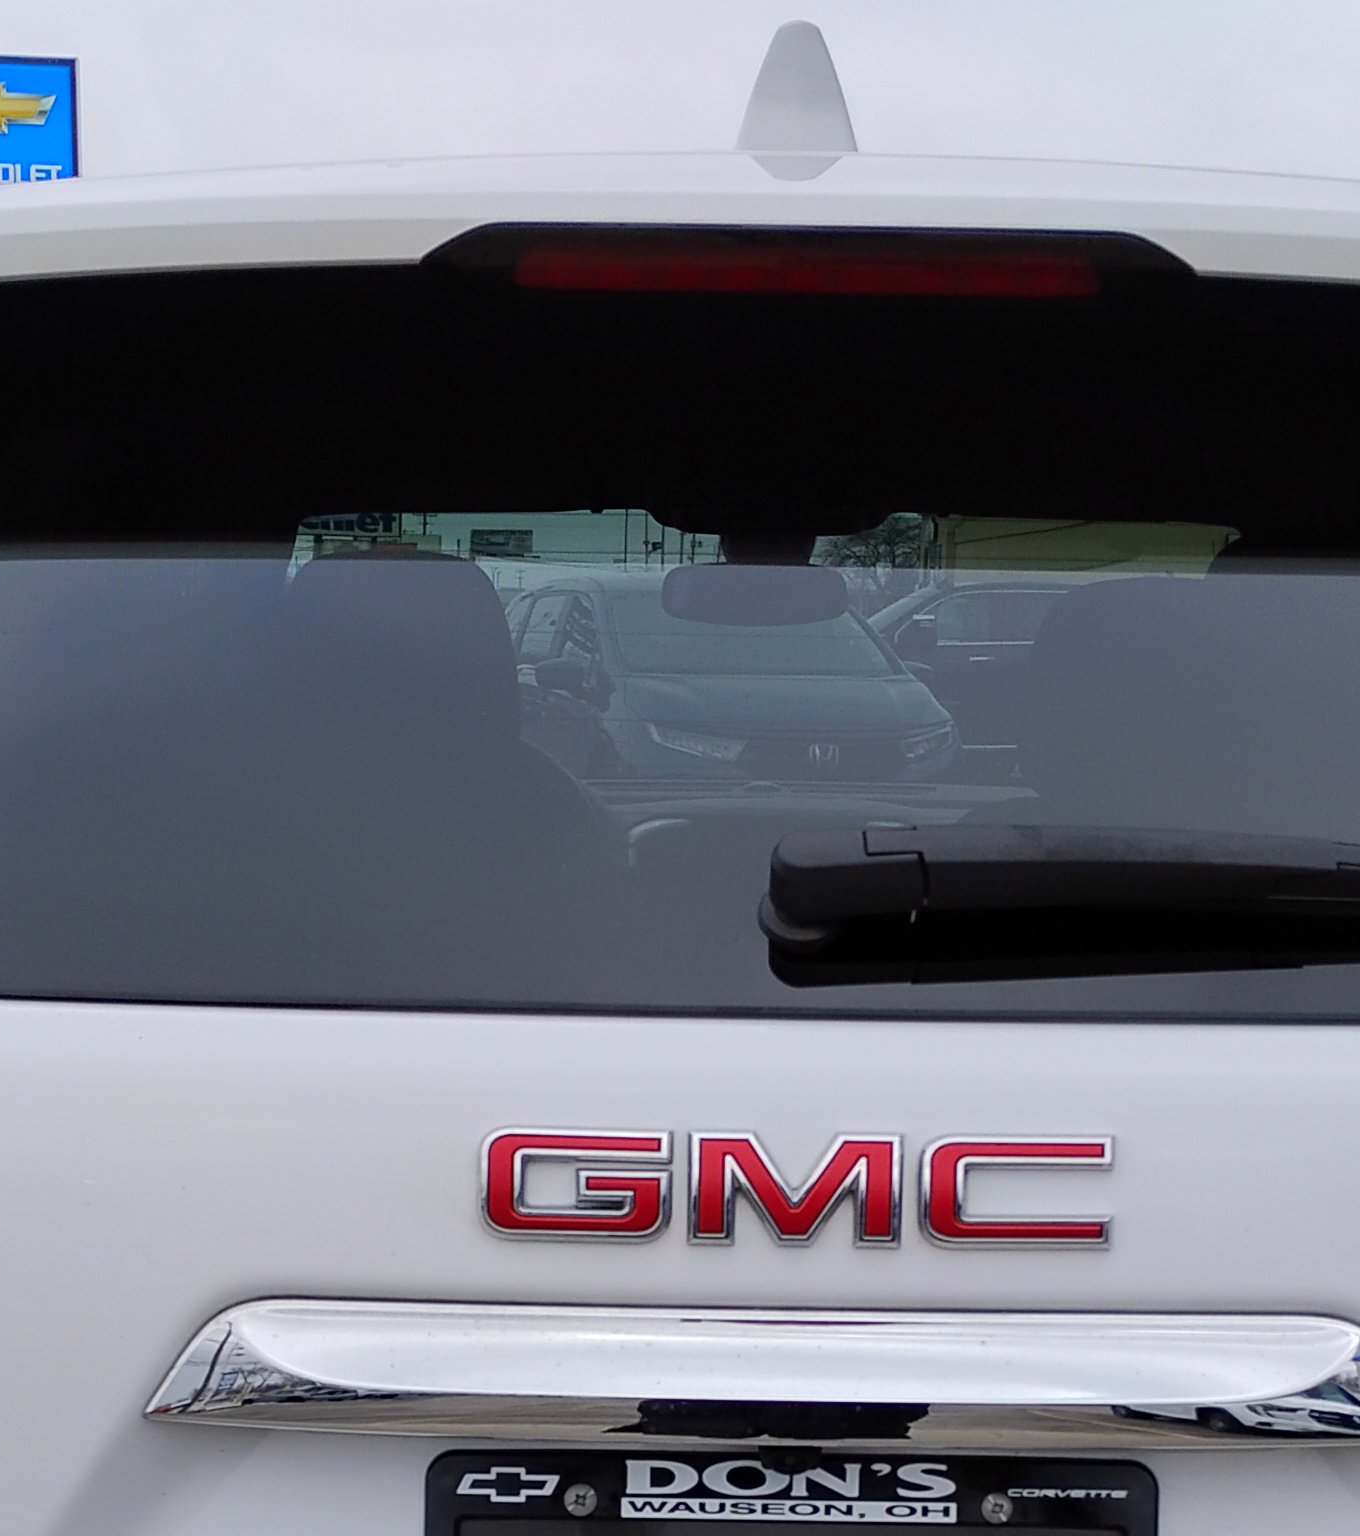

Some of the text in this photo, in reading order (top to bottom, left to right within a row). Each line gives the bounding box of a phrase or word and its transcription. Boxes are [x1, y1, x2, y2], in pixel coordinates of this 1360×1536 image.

[481, 1126, 1115, 1250] GMC
[625, 1459, 957, 1498] DON'S
[1006, 1487, 1129, 1499] CORVETTE
[627, 1500, 951, 1519] WAUSEON, OH
